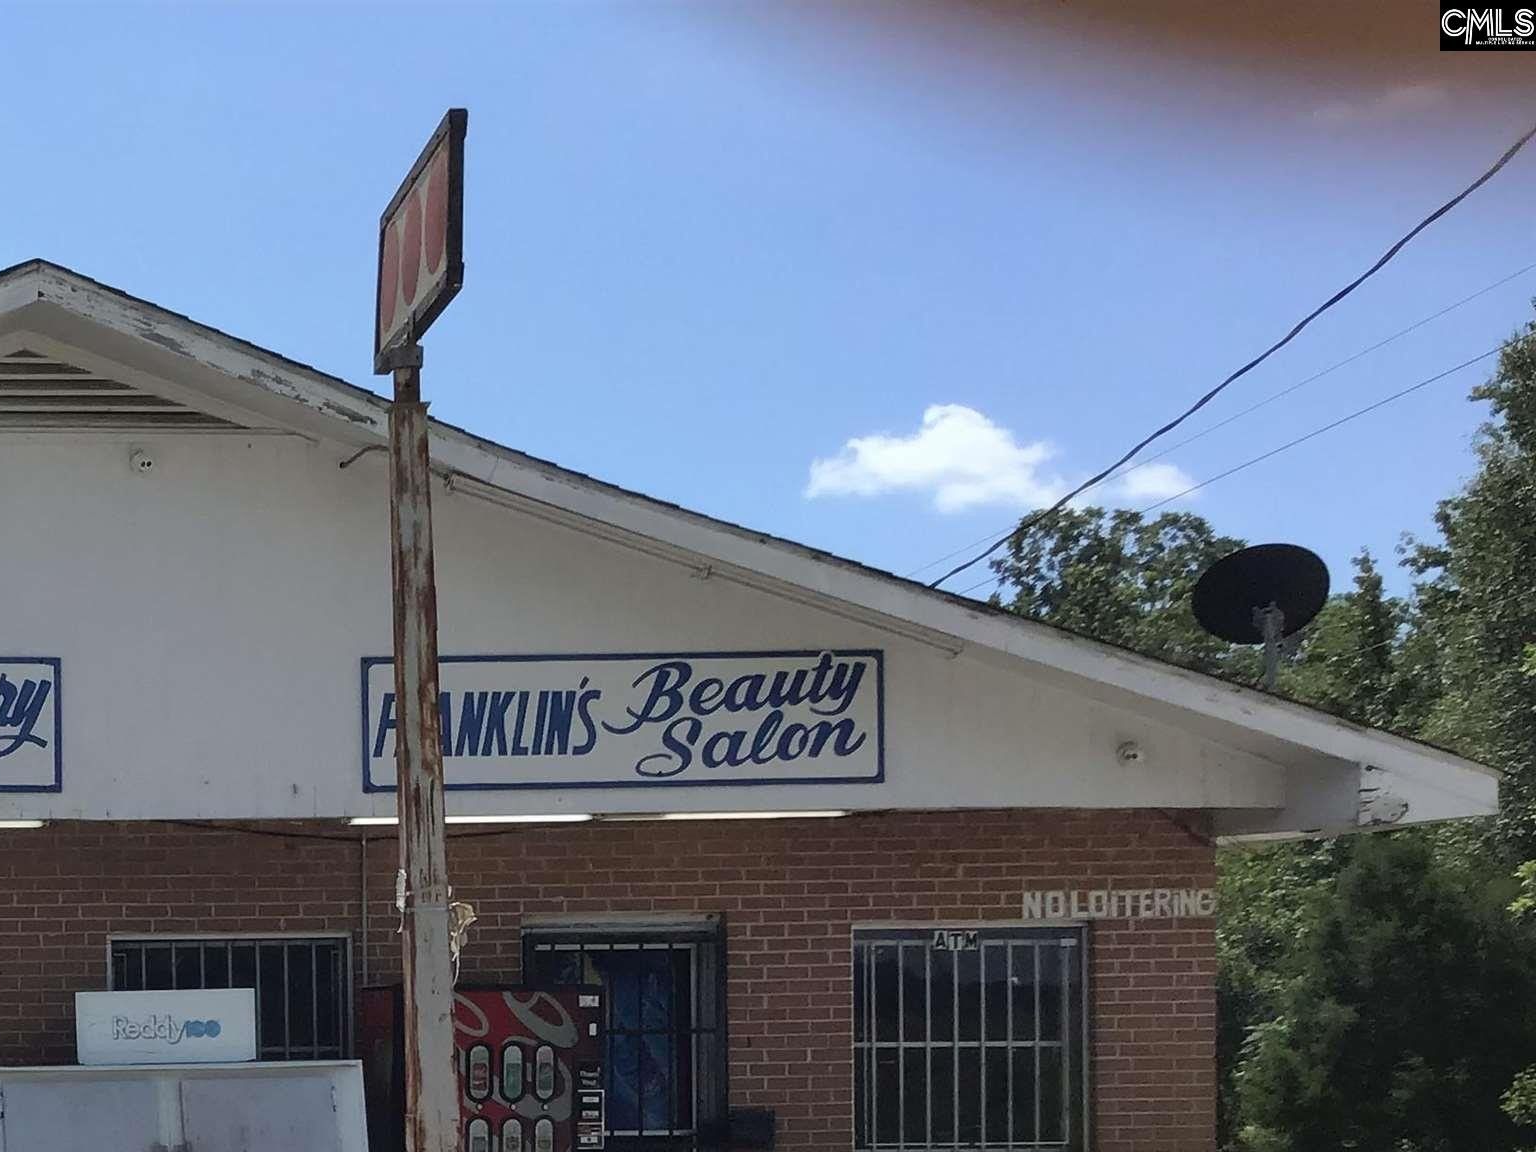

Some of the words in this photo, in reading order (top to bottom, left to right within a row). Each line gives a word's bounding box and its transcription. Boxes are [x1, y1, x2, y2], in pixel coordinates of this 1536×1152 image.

[372, 676, 602, 759] FANKLIN'S
[600, 651, 867, 735] Beauty
[635, 709, 867, 778] Salon
[1023, 890, 1064, 920] NO
[1069, 888, 1215, 919] LOITERING
[933, 930, 979, 951] ATM
